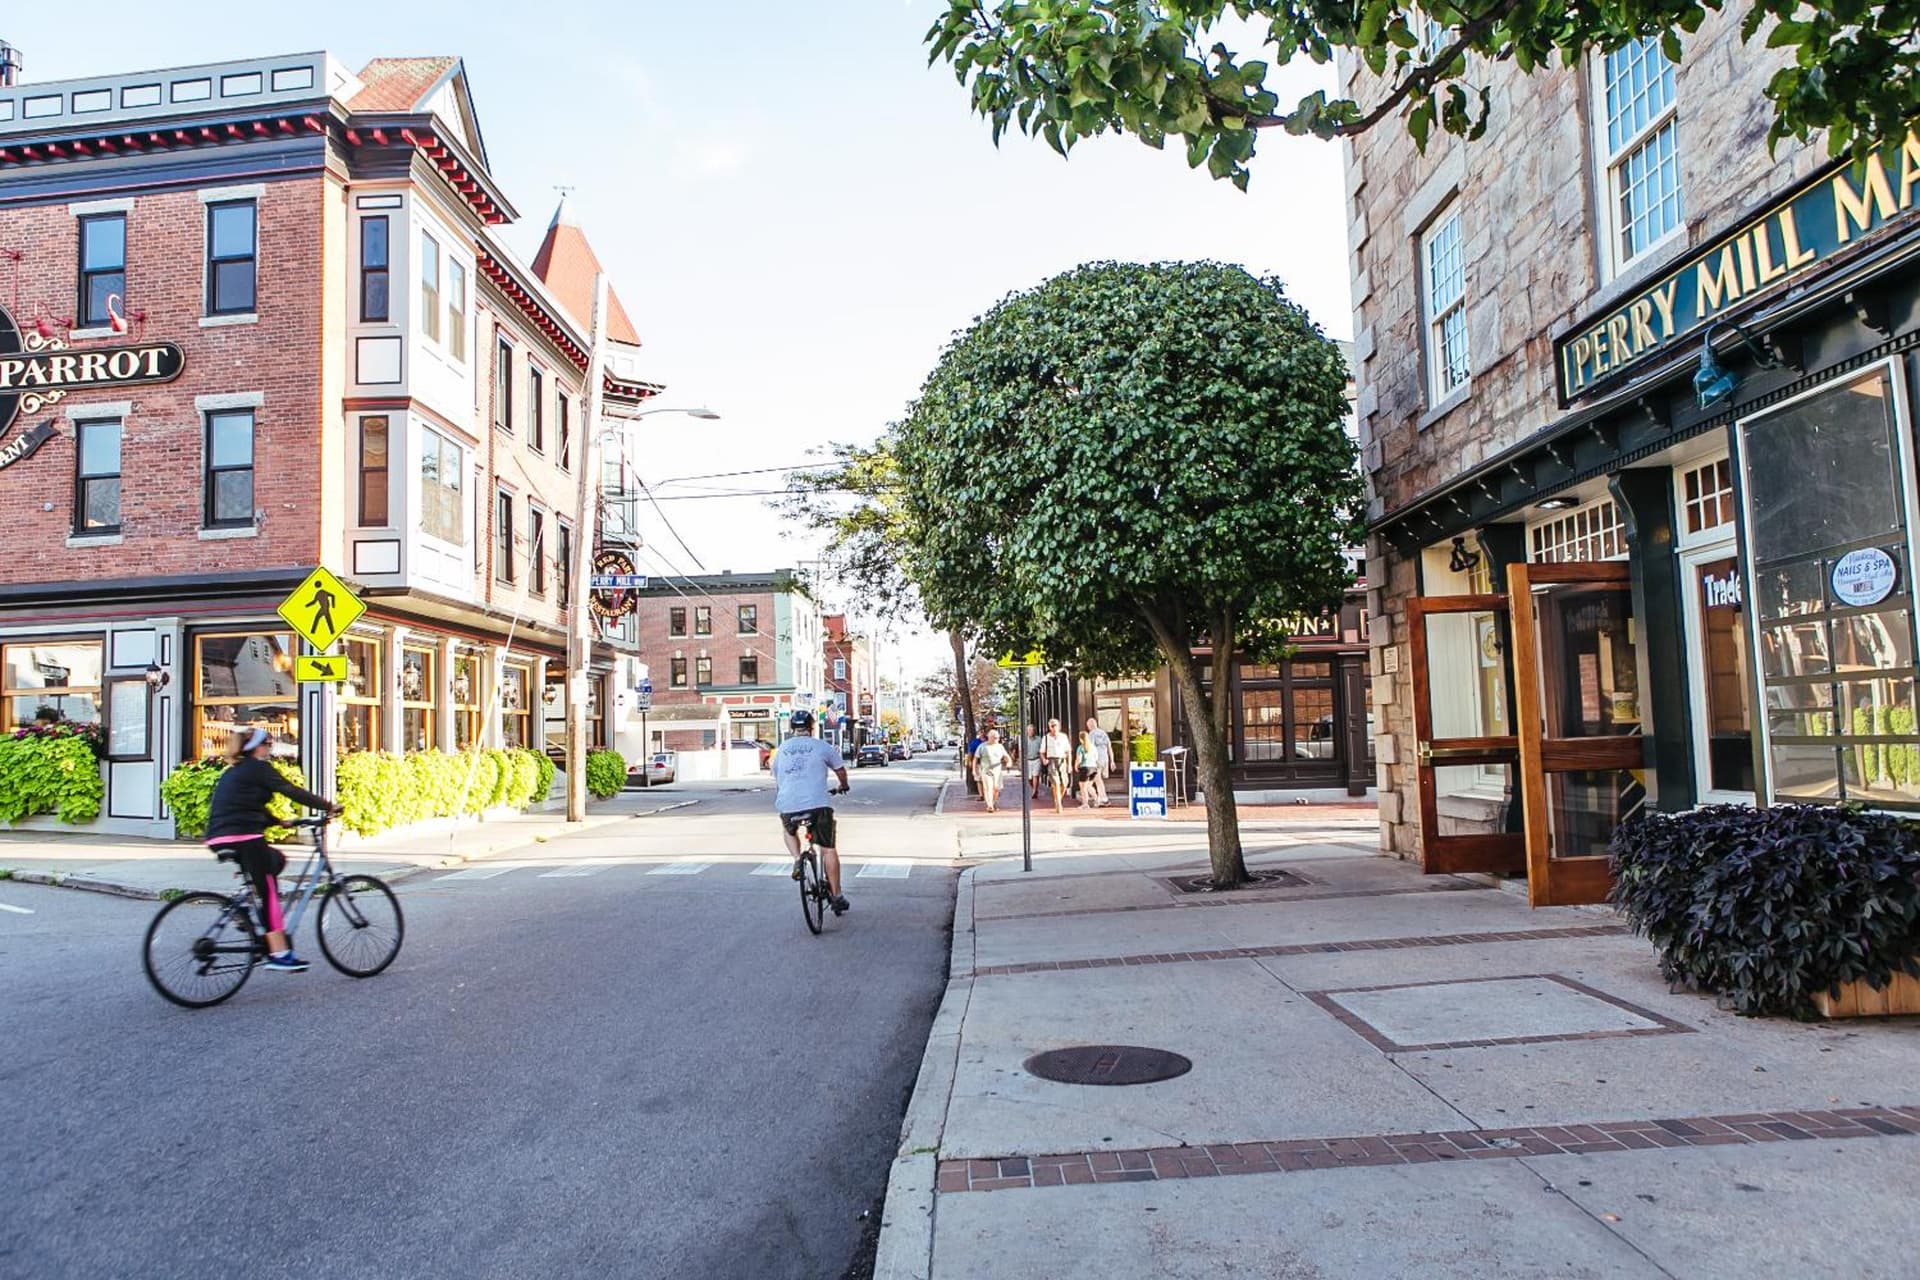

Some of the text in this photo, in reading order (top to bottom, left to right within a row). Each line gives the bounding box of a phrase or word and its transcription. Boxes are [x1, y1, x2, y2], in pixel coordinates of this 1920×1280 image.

[1574, 279, 1678, 390] PERRY
[1696, 205, 1815, 318] MILL
[0, 348, 169, 388] PARROT
[1838, 557, 1891, 577] NAILS & SPA
[616, 576, 631, 587] MILL
[1142, 771, 1155, 785] P
[1132, 786, 1165, 799] PARKING
